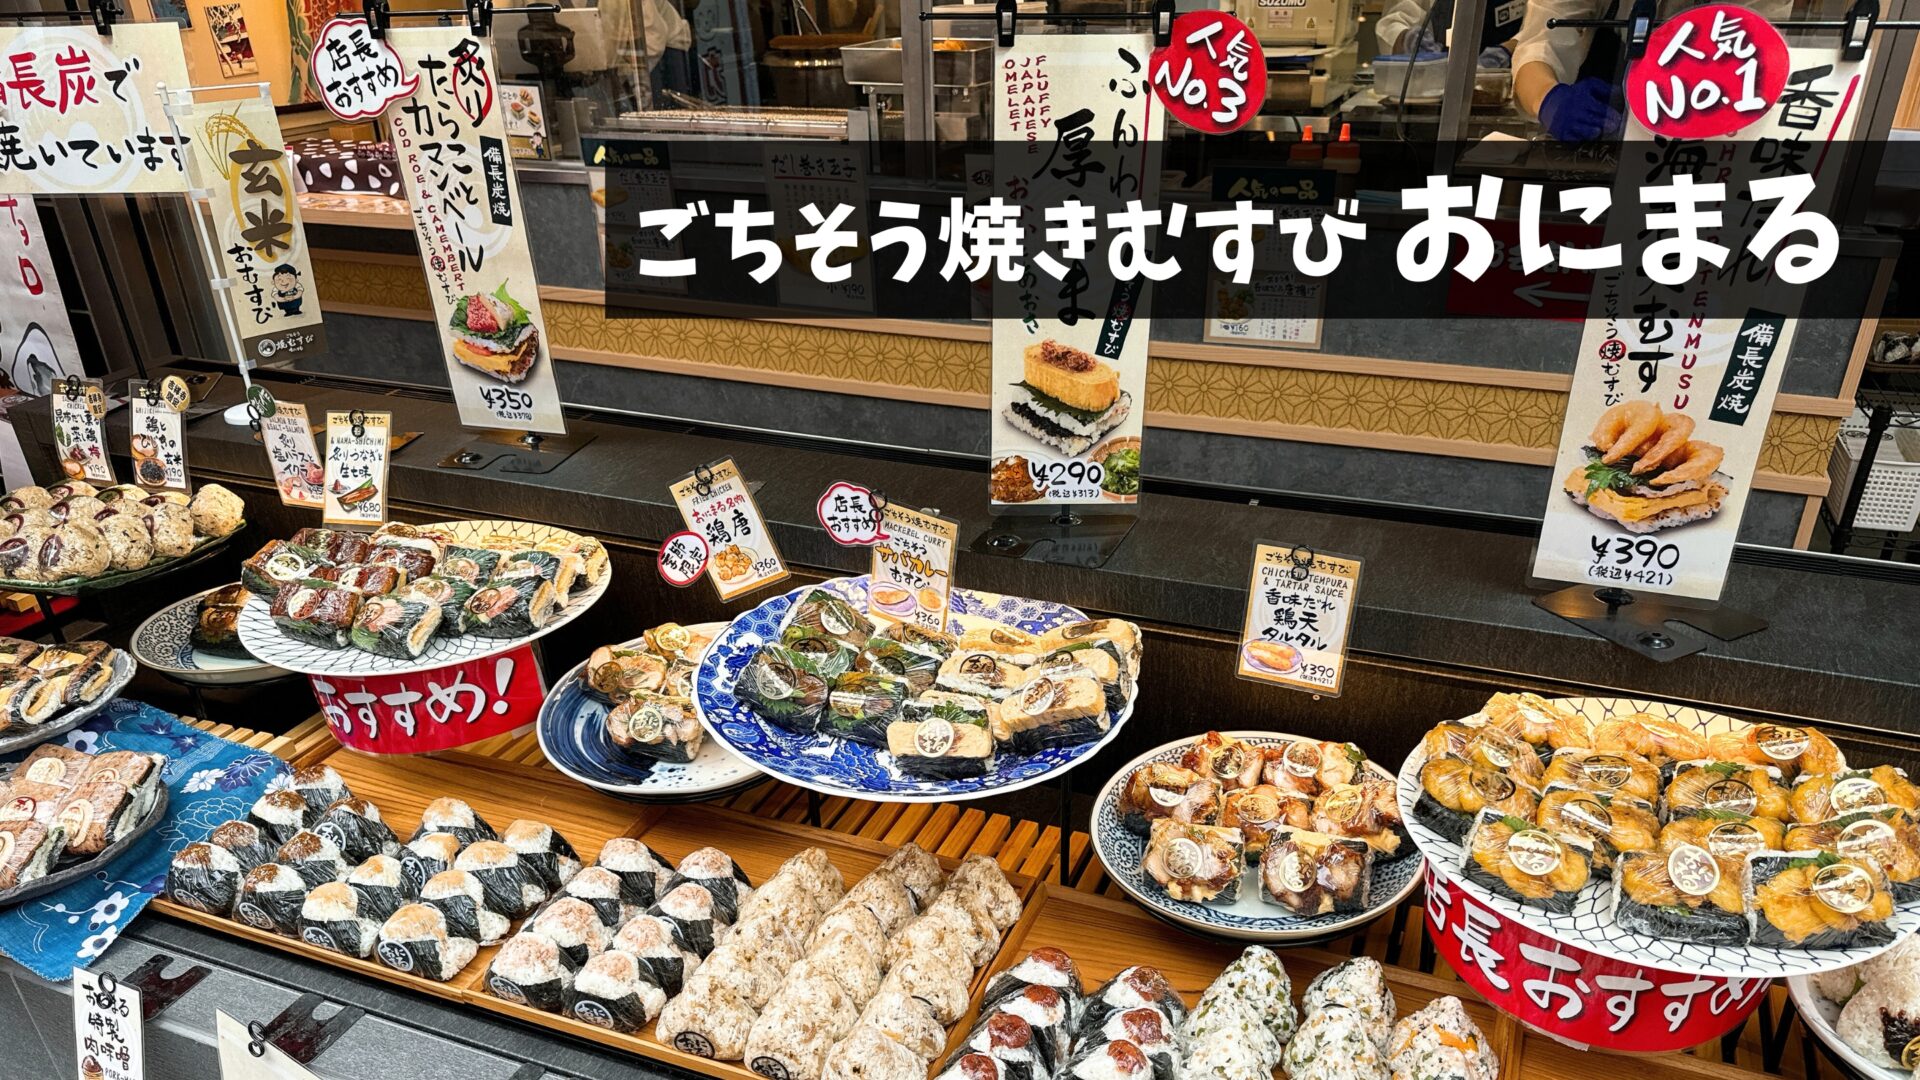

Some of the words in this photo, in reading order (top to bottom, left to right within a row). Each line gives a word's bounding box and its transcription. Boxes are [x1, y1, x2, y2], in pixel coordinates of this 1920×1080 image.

[326, 29, 379, 72] 店長
[1186, 20, 1254, 82] 人気
[1658, 10, 1756, 66] 人気
[326, 59, 399, 109] おすすめ
[449, 37, 490, 128] 炙り
[1002, 59, 1021, 132] OMELET
[1034, 55, 1052, 129] FLUFFY
[1154, 57, 1247, 124] No.3
[1646, 58, 1767, 125] No.1
[1020, 57, 1039, 154] JAPANESE
[418, 54, 479, 206] たらこと
[228, 139, 294, 258] 玄米
[402, 96, 485, 274] カマンベール
[482, 146, 511, 218] 備長炭焼
[394, 117, 412, 149] COD
[408, 153, 426, 184] ROE
[427, 204, 466, 292] CAMEMBERT
[1031, 108, 1107, 327] 厚ま
[227, 243, 276, 325] おむすび
[1716, 322, 1774, 415] 備長炭焼
[479, 386, 533, 410] ¥350
[340, 463, 372, 479] 生七味
[1031, 461, 1102, 488] ¥290
[834, 494, 867, 514] 店長
[705, 508, 752, 547] 鶏唐
[827, 515, 877, 533] おすすめ
[923, 534, 948, 549] CURRY
[875, 542, 948, 578] サバカレー
[894, 536, 928, 556] ごちそう
[1590, 534, 1681, 571] ¥390
[752, 557, 777, 575] ¥360
[889, 566, 931, 590] むすび
[1308, 574, 1349, 590] TEMPURA
[1265, 588, 1336, 614] 香味だれ
[1275, 578, 1310, 592] TARTAR
[1314, 585, 1345, 599] SAUCE
[1262, 626, 1328, 651] タルタル
[1273, 608, 1320, 632] 鶏天
[1300, 662, 1335, 678] ¥390
[311, 656, 515, 739] おすすめ!
[82, 980, 130, 1018] おまる
[87, 1011, 125, 1044] 特製
[84, 1033, 131, 1071] 肉味噌
